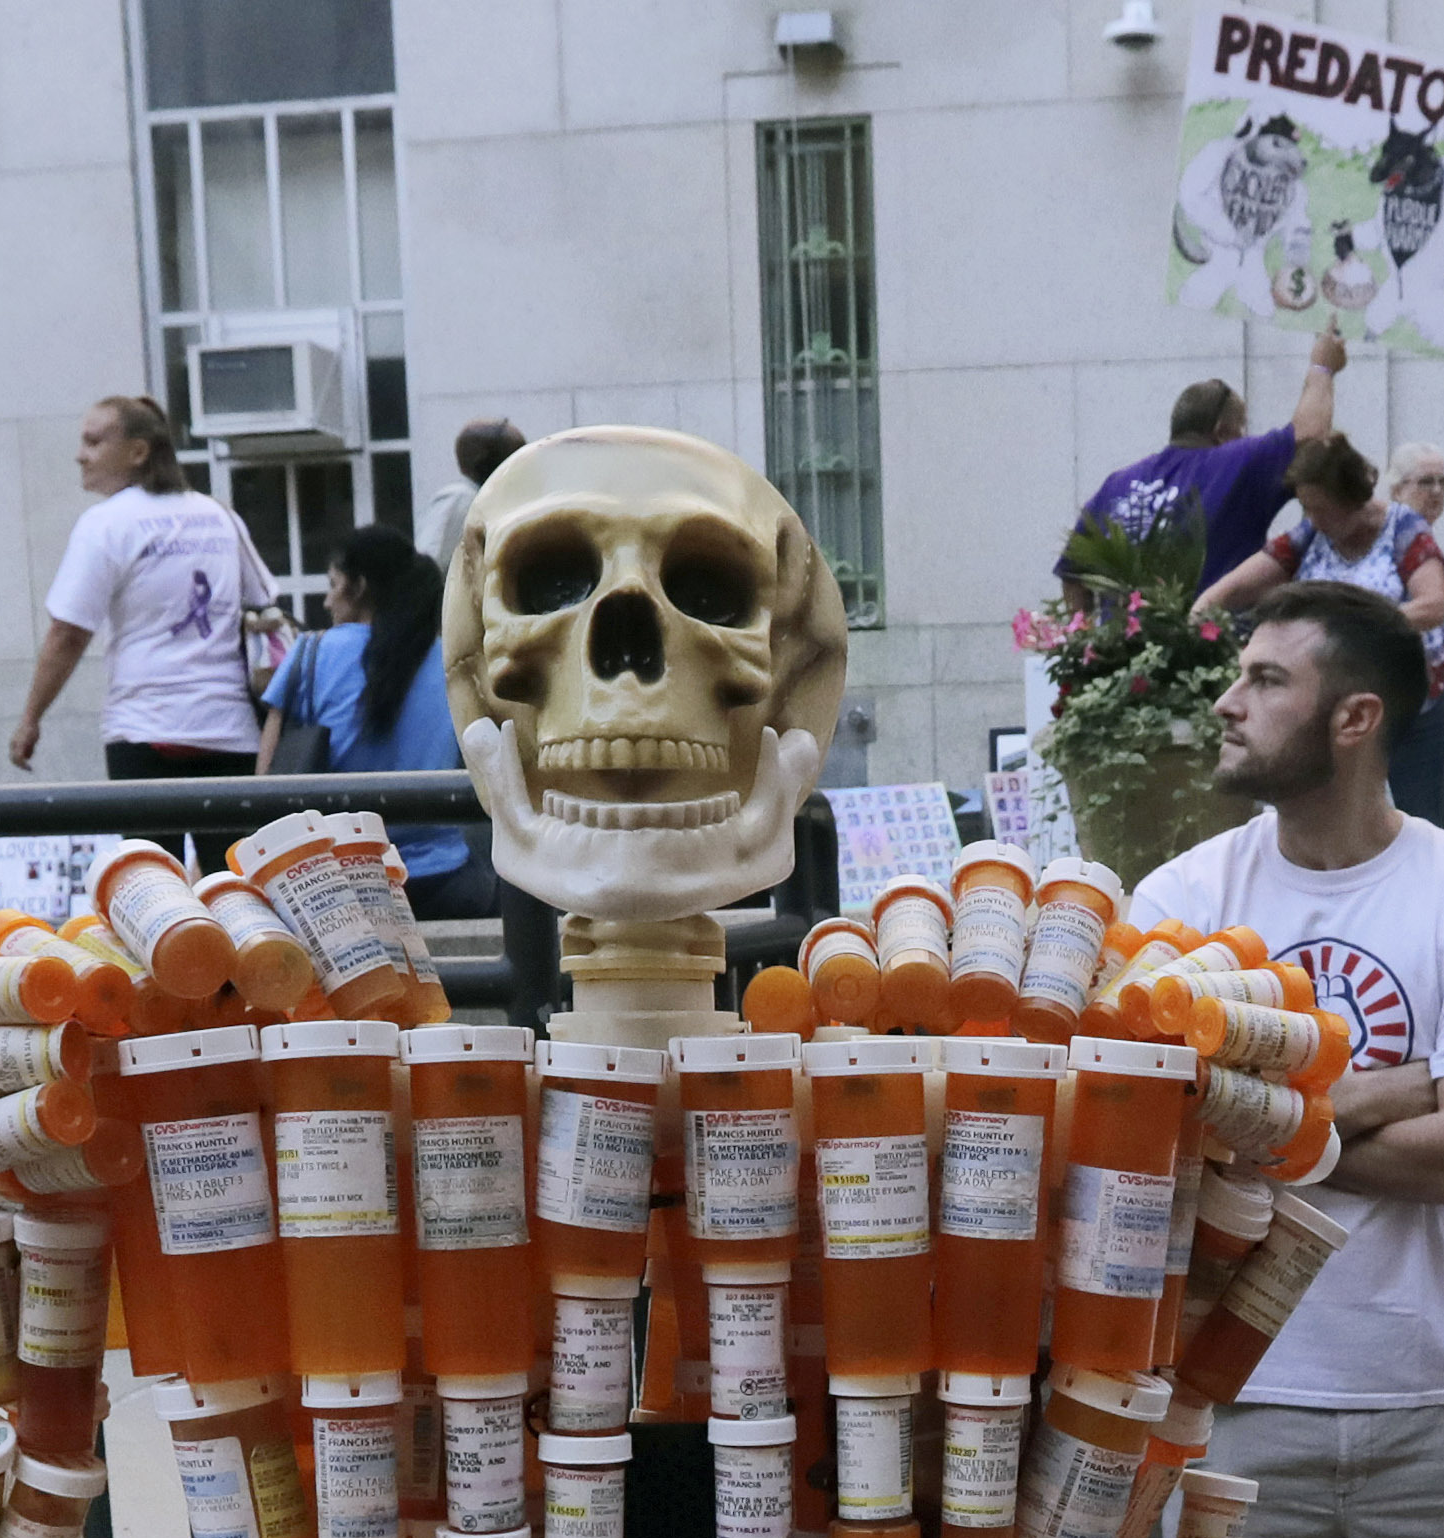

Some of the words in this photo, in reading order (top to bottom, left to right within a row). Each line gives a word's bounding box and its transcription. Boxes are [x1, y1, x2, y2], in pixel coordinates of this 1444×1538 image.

[293, 872, 330, 894] FRANCIS
[311, 897, 336, 913] TABLET
[974, 898, 1013, 910] HUNTLEY
[313, 914, 337, 928] TAKE
[1041, 915, 1076, 923] FRANCIS
[317, 916, 352, 938] MOUTH
[595, 1100, 653, 1114] CVS/pharm
[706, 1113, 776, 1124] CVS/pharmacy
[155, 1119, 229, 1135] CVS/pharmacy
[594, 1119, 632, 1131] FRANCIS
[707, 1129, 745, 1138] FRANCIS
[747, 1128, 783, 1137] HUNTLEY
[973, 1132, 1015, 1141] HUNTLEY
[157, 1142, 193, 1152] FRANCIS
[195, 1136, 239, 1148] HUNTLEY
[451, 1136, 495, 1145] HUNTLEY
[606, 1144, 621, 1152] MG
[719, 1143, 775, 1153] METHADONE
[952, 1144, 999, 1155] METHADOSE
[1004, 1147, 1013, 1156] 10
[169, 1151, 228, 1166] METHADOSE
[428, 1152, 483, 1161] METHADONE
[709, 1153, 719, 1161] 10
[721, 1153, 736, 1161] MG
[739, 1152, 771, 1160] TABLET
[317, 1162, 340, 1170] TWICE
[444, 1161, 477, 1169] TABLET
[590, 1157, 615, 1168] TAKE
[162, 1165, 191, 1175] TABLET
[589, 1167, 618, 1179] TIMES
[621, 1170, 627, 1179] A
[709, 1167, 734, 1178] TAKE
[745, 1166, 782, 1177] TABLETS
[969, 1168, 1010, 1180] TABLETS
[165, 1181, 187, 1191] TAKE
[197, 1177, 233, 1188] TABLET
[238, 1176, 243, 1184] 3
[710, 1177, 738, 1187] TIMES
[741, 1178, 748, 1186] A
[750, 1177, 771, 1186] DAY
[964, 1177, 970, 1185] A
[973, 1179, 993, 1188] DAY
[167, 1191, 191, 1201] TIMES
[194, 1190, 202, 1198] A
[204, 1188, 227, 1198] DAY
[848, 1187, 880, 1196] TABLETS
[1116, 1196, 1154, 1207] FRANCIS
[594, 1360, 611, 1368] AND
[567, 1368, 586, 1376] PAIN
[329, 1438, 370, 1448] FRANCIS
[488, 1458, 506, 1466] AND
[329, 1465, 361, 1473] TABLET
[331, 1479, 354, 1488] TAKE
[331, 1488, 369, 1498] MOUTH
